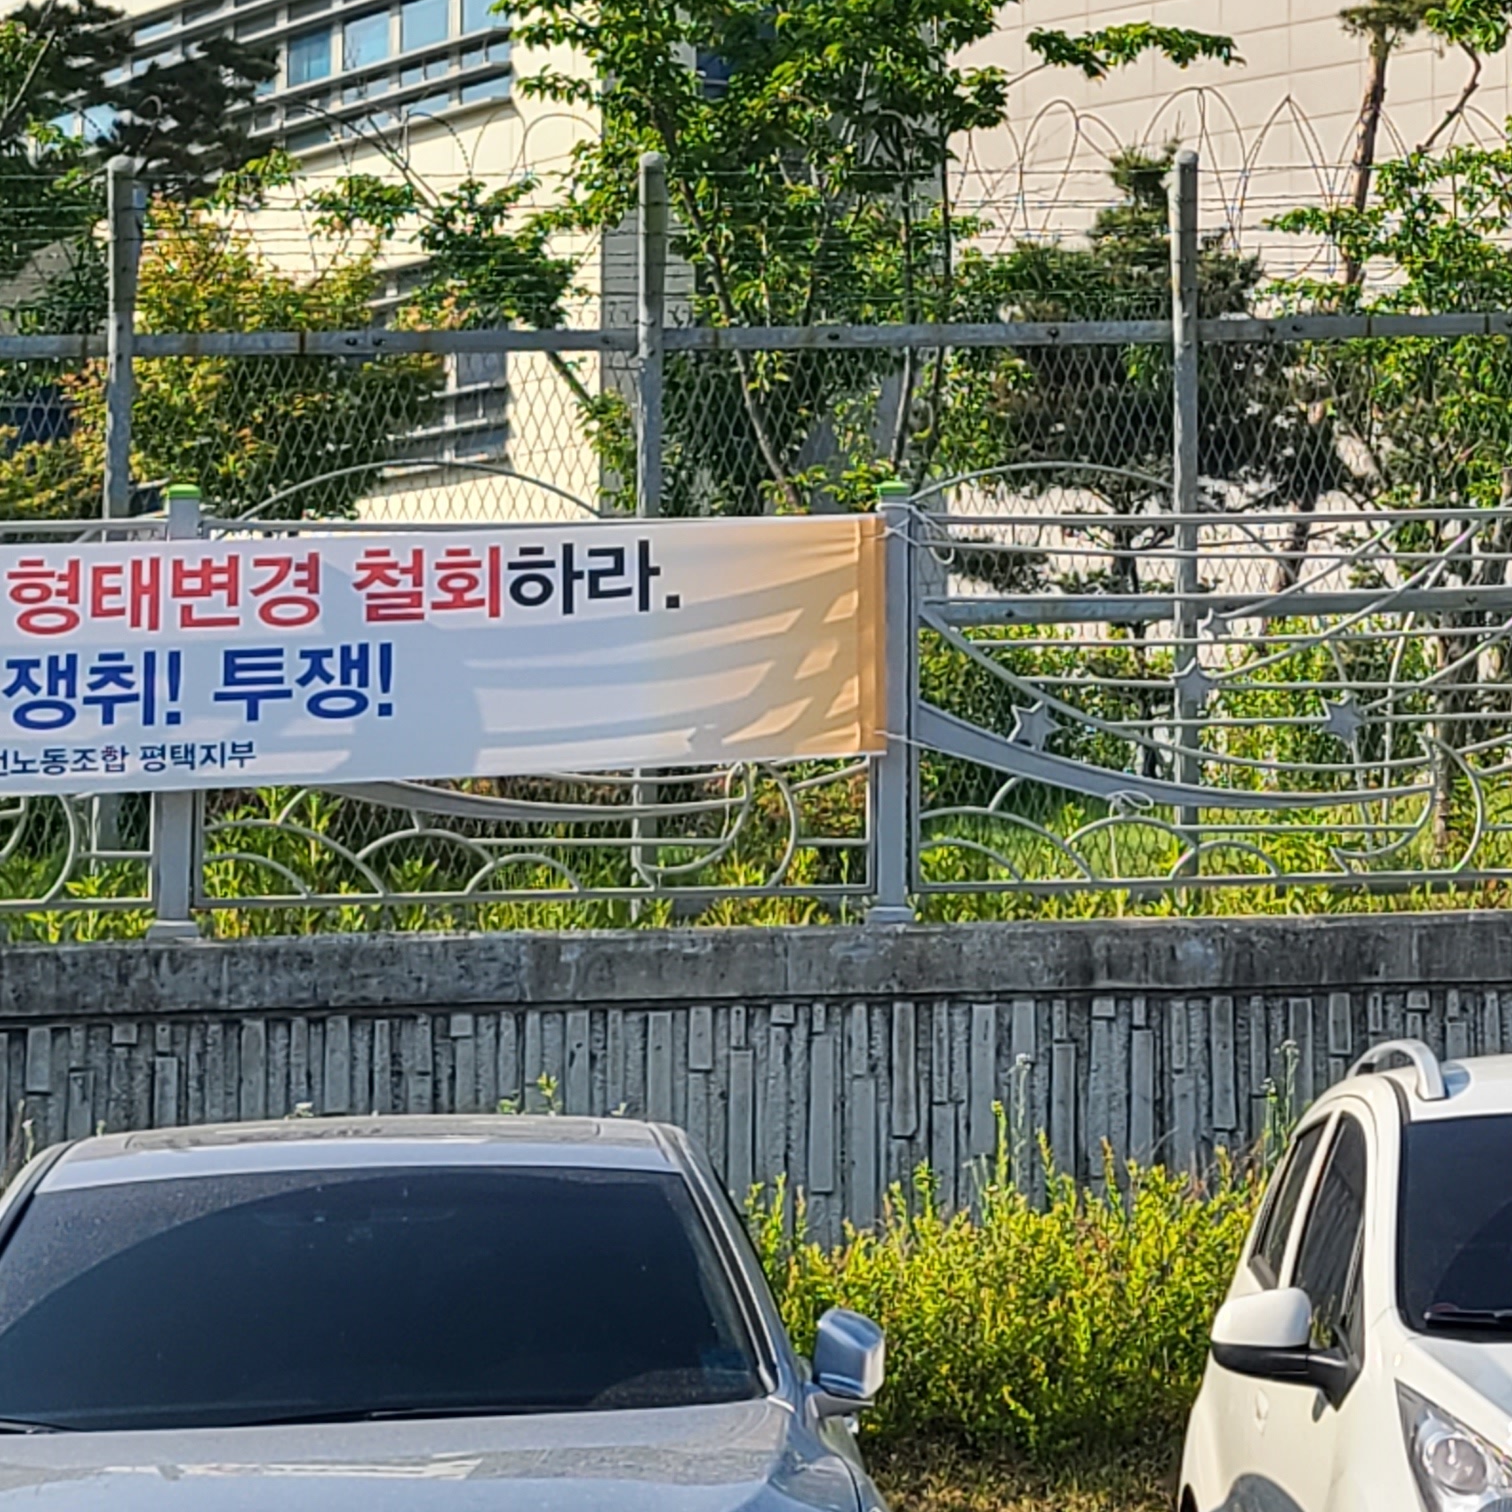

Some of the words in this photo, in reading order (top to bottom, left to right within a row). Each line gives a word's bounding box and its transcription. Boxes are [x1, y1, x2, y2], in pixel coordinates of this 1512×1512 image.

[7, 551, 320, 635] 형태변경
[352, 540, 681, 622] 철회하라.
[2, 650, 182, 730] 쟁취!
[213, 642, 393, 723] 투쟁!
[139, 741, 257, 772] 평택지부
